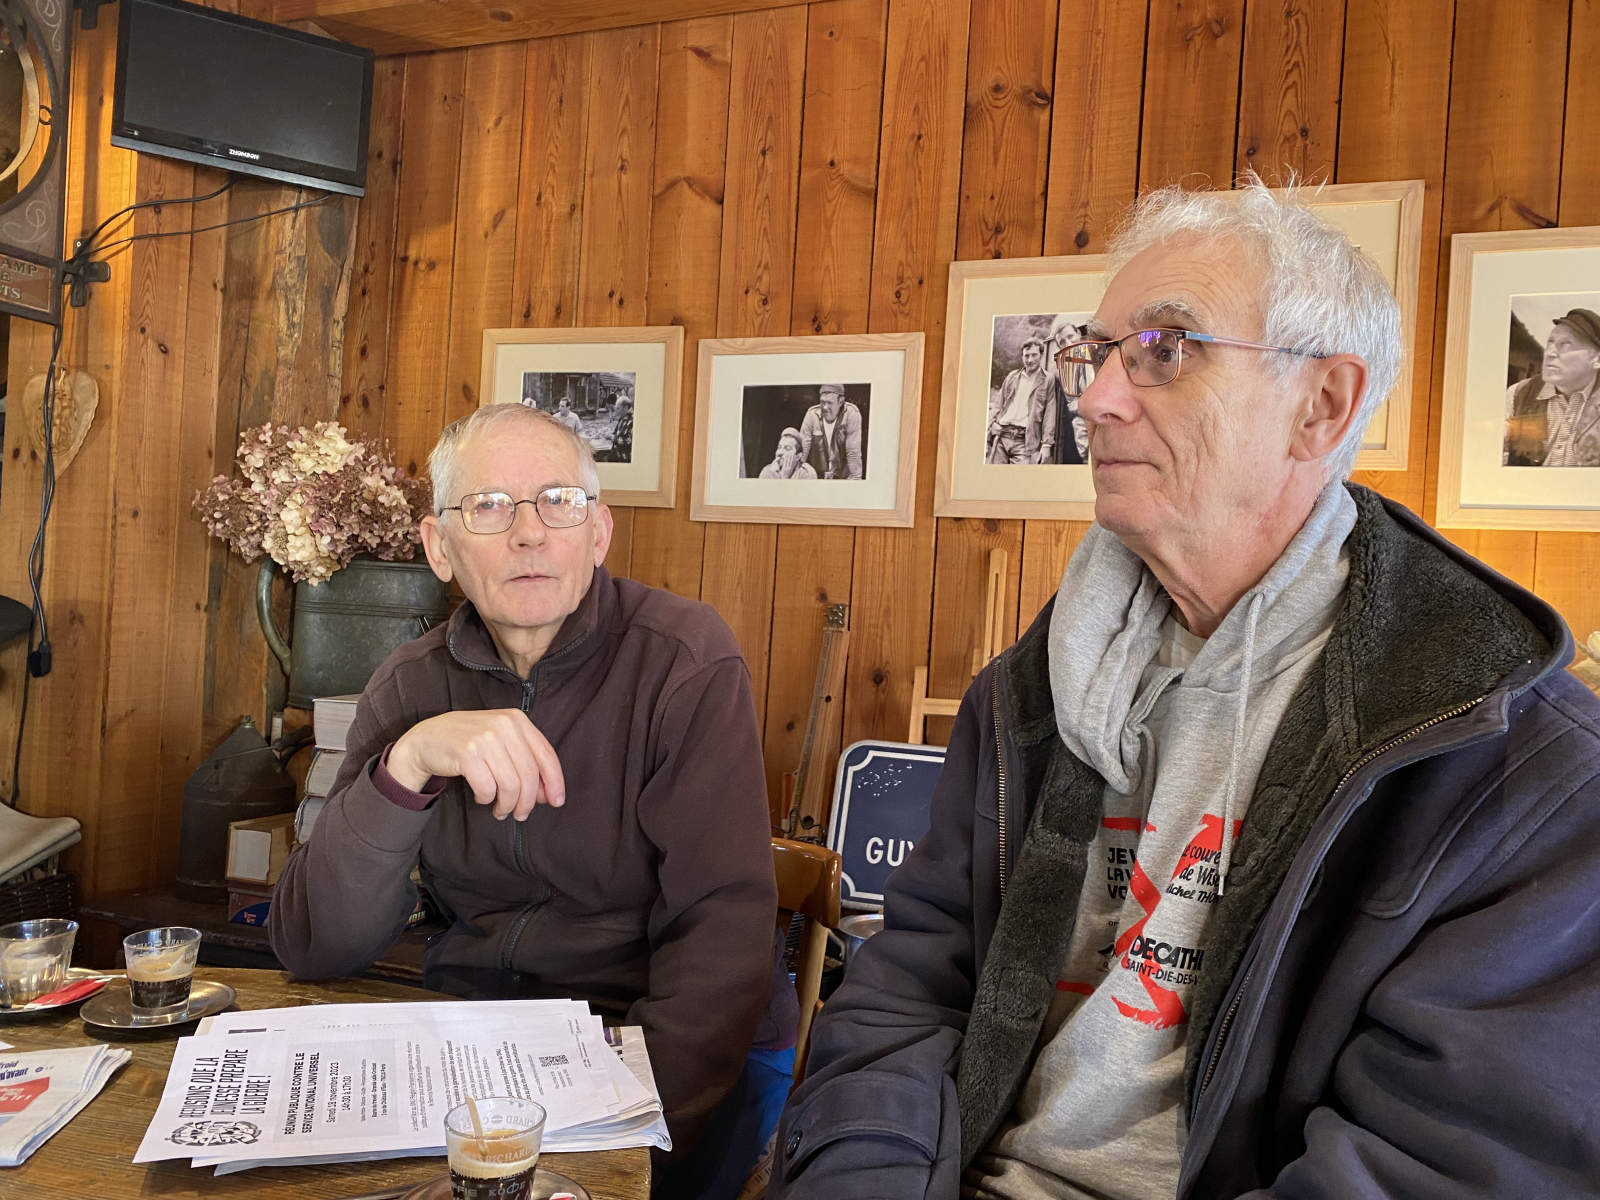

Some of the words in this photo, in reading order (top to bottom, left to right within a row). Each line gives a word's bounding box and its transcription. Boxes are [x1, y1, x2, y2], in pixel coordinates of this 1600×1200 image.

[229, 148, 260, 161] THOMSON
[865, 836, 915, 867] GU
[1107, 847, 1128, 864] JE
[194, 1057, 219, 1067] LA
[295, 1052, 304, 1061] LE
[190, 1068, 217, 1084] QUE
[292, 1062, 304, 1086] CONTRE
[308, 1052, 320, 1086] UNIVERSEL
[242, 1079, 271, 1106] GUERRE
[288, 1086, 301, 1114] PUBLIQUE
[305, 1086, 316, 1113] NATIONAL
[329, 1077, 338, 1101] novembre
[178, 1085, 213, 1119] REFUSONS
[210, 1085, 241, 1116] JEUNESSE
[240, 1106, 266, 1115] LA
[282, 1114, 298, 1135] RÉUNION
[302, 1114, 314, 1134] SERVICE
[326, 1108, 336, 1123] Samedi
